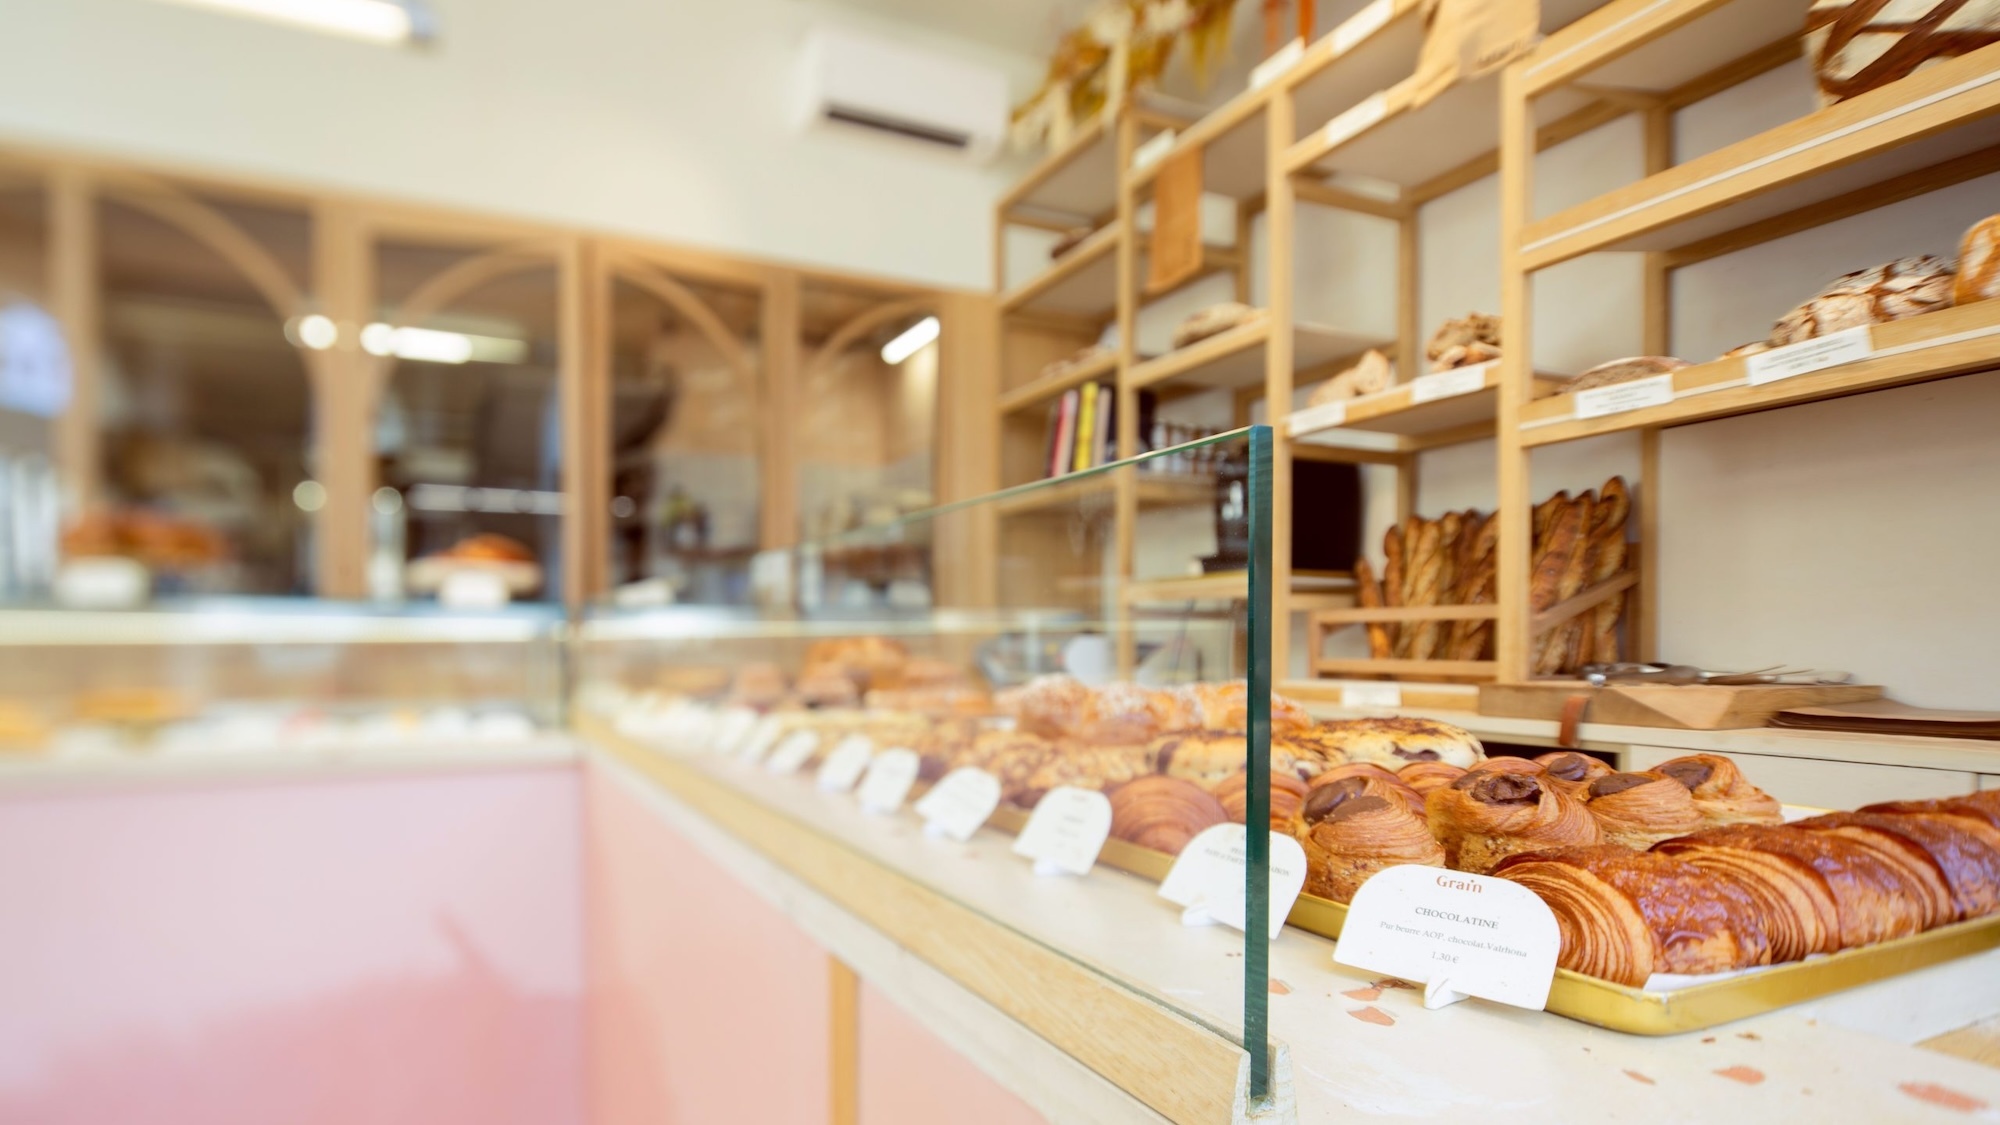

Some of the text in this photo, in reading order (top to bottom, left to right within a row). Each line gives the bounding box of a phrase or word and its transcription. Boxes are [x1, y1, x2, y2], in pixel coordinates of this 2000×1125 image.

[1436, 875, 1483, 893] Grain
[1415, 906, 1499, 930] CHOCOLATINE
[1380, 921, 1394, 930] Pur
[1395, 924, 1421, 936] beurre
[1487, 942, 1527, 958] Valrhona
